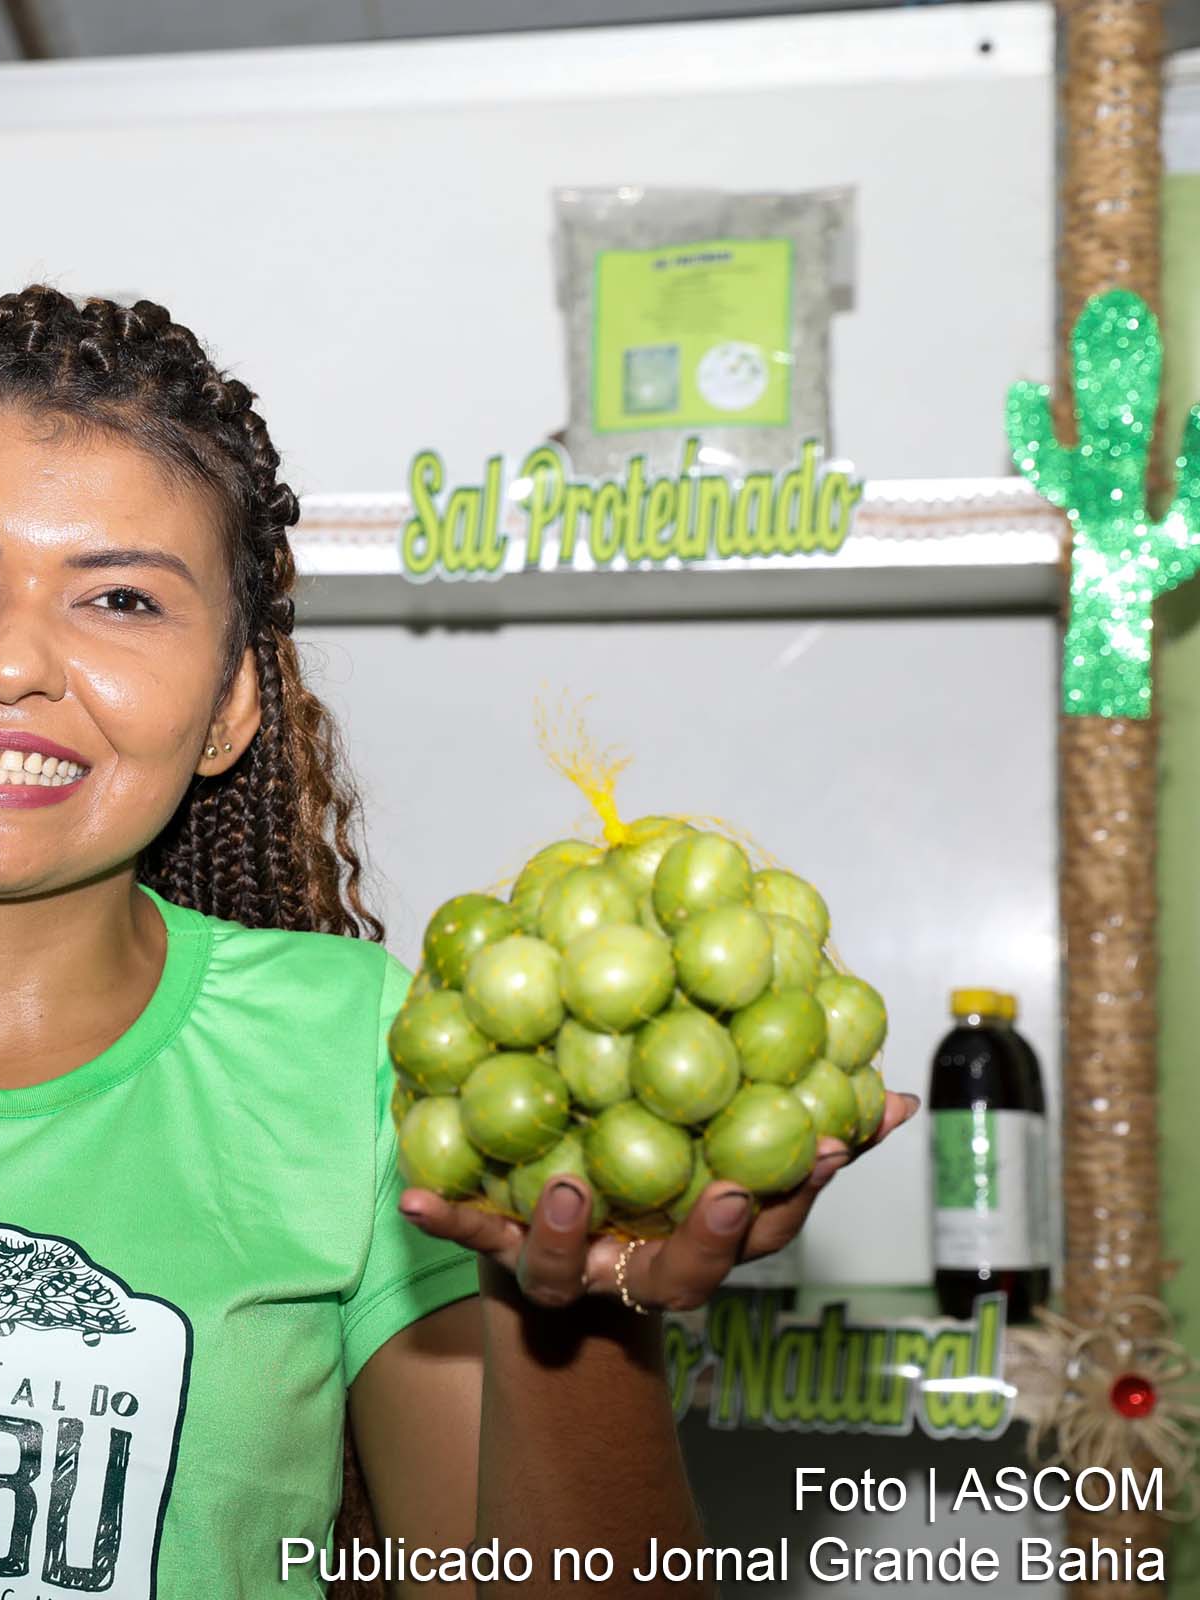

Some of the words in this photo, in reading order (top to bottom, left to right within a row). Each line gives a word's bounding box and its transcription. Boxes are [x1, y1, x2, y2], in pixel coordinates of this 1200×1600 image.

[402, 449, 508, 575] Sal
[89, 1384, 140, 1418] DO
[707, 1295, 1010, 1430] Natural
